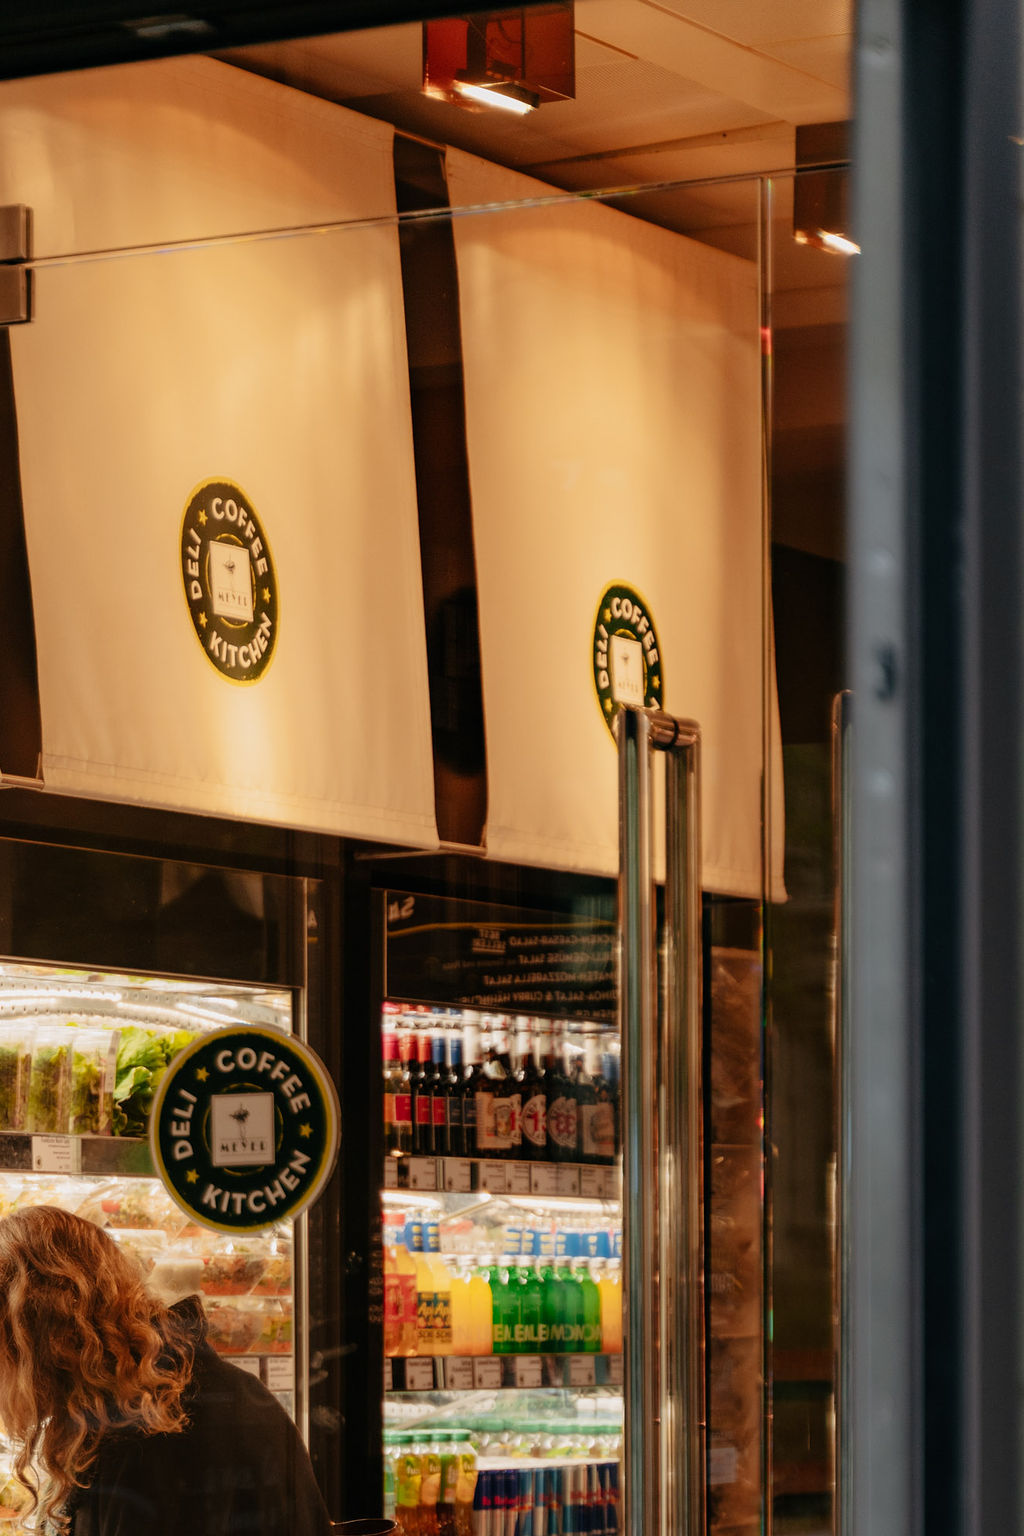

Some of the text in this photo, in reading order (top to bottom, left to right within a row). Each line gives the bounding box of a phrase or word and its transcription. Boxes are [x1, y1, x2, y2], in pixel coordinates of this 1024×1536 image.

[187, 527, 203, 601] DELI
[211, 497, 269, 577] COFFEE
[209, 611, 273, 669] KITCHEN
[596, 623, 610, 691] DELI
[610, 596, 659, 667] COFFEE
[215, 1047, 312, 1115] COFFEE
[171, 1088, 198, 1161] DELI
[202, 1149, 312, 1216] KITCHEN
